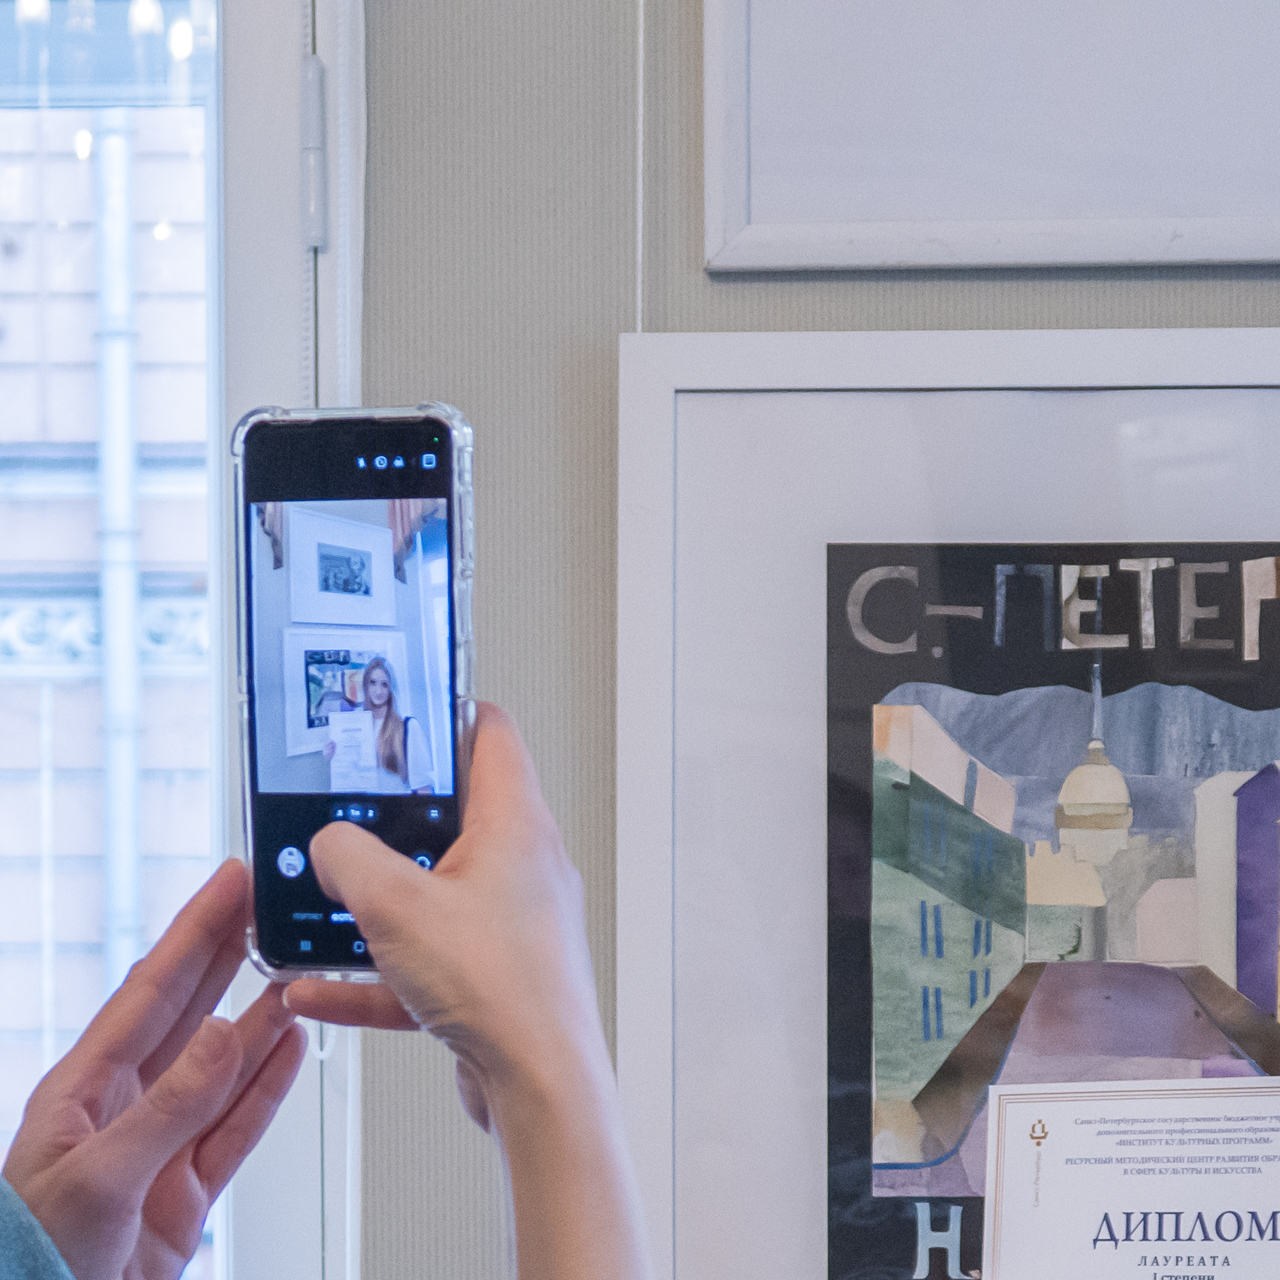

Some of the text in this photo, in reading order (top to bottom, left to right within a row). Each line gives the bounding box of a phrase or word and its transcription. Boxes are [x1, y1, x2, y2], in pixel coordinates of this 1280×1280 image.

[1165, 1127, 1243, 1136] профессионального
[1165, 1138, 1221, 1146] КУЛЬТУРНЫХ
[1222, 1137, 1273, 1145] ПРОГРАММ»
[1065, 1156, 1114, 1165] РЕСУРСНЫЙ
[1115, 1155, 1184, 1164] МЕТОДИЧЕСКИЙ
[1187, 1155, 1214, 1164] ЦЕНТР
[1216, 1155, 1259, 1163] РАЗВИТИЯ
[1138, 1256, 1231, 1266] ЛАУРЕАТА
